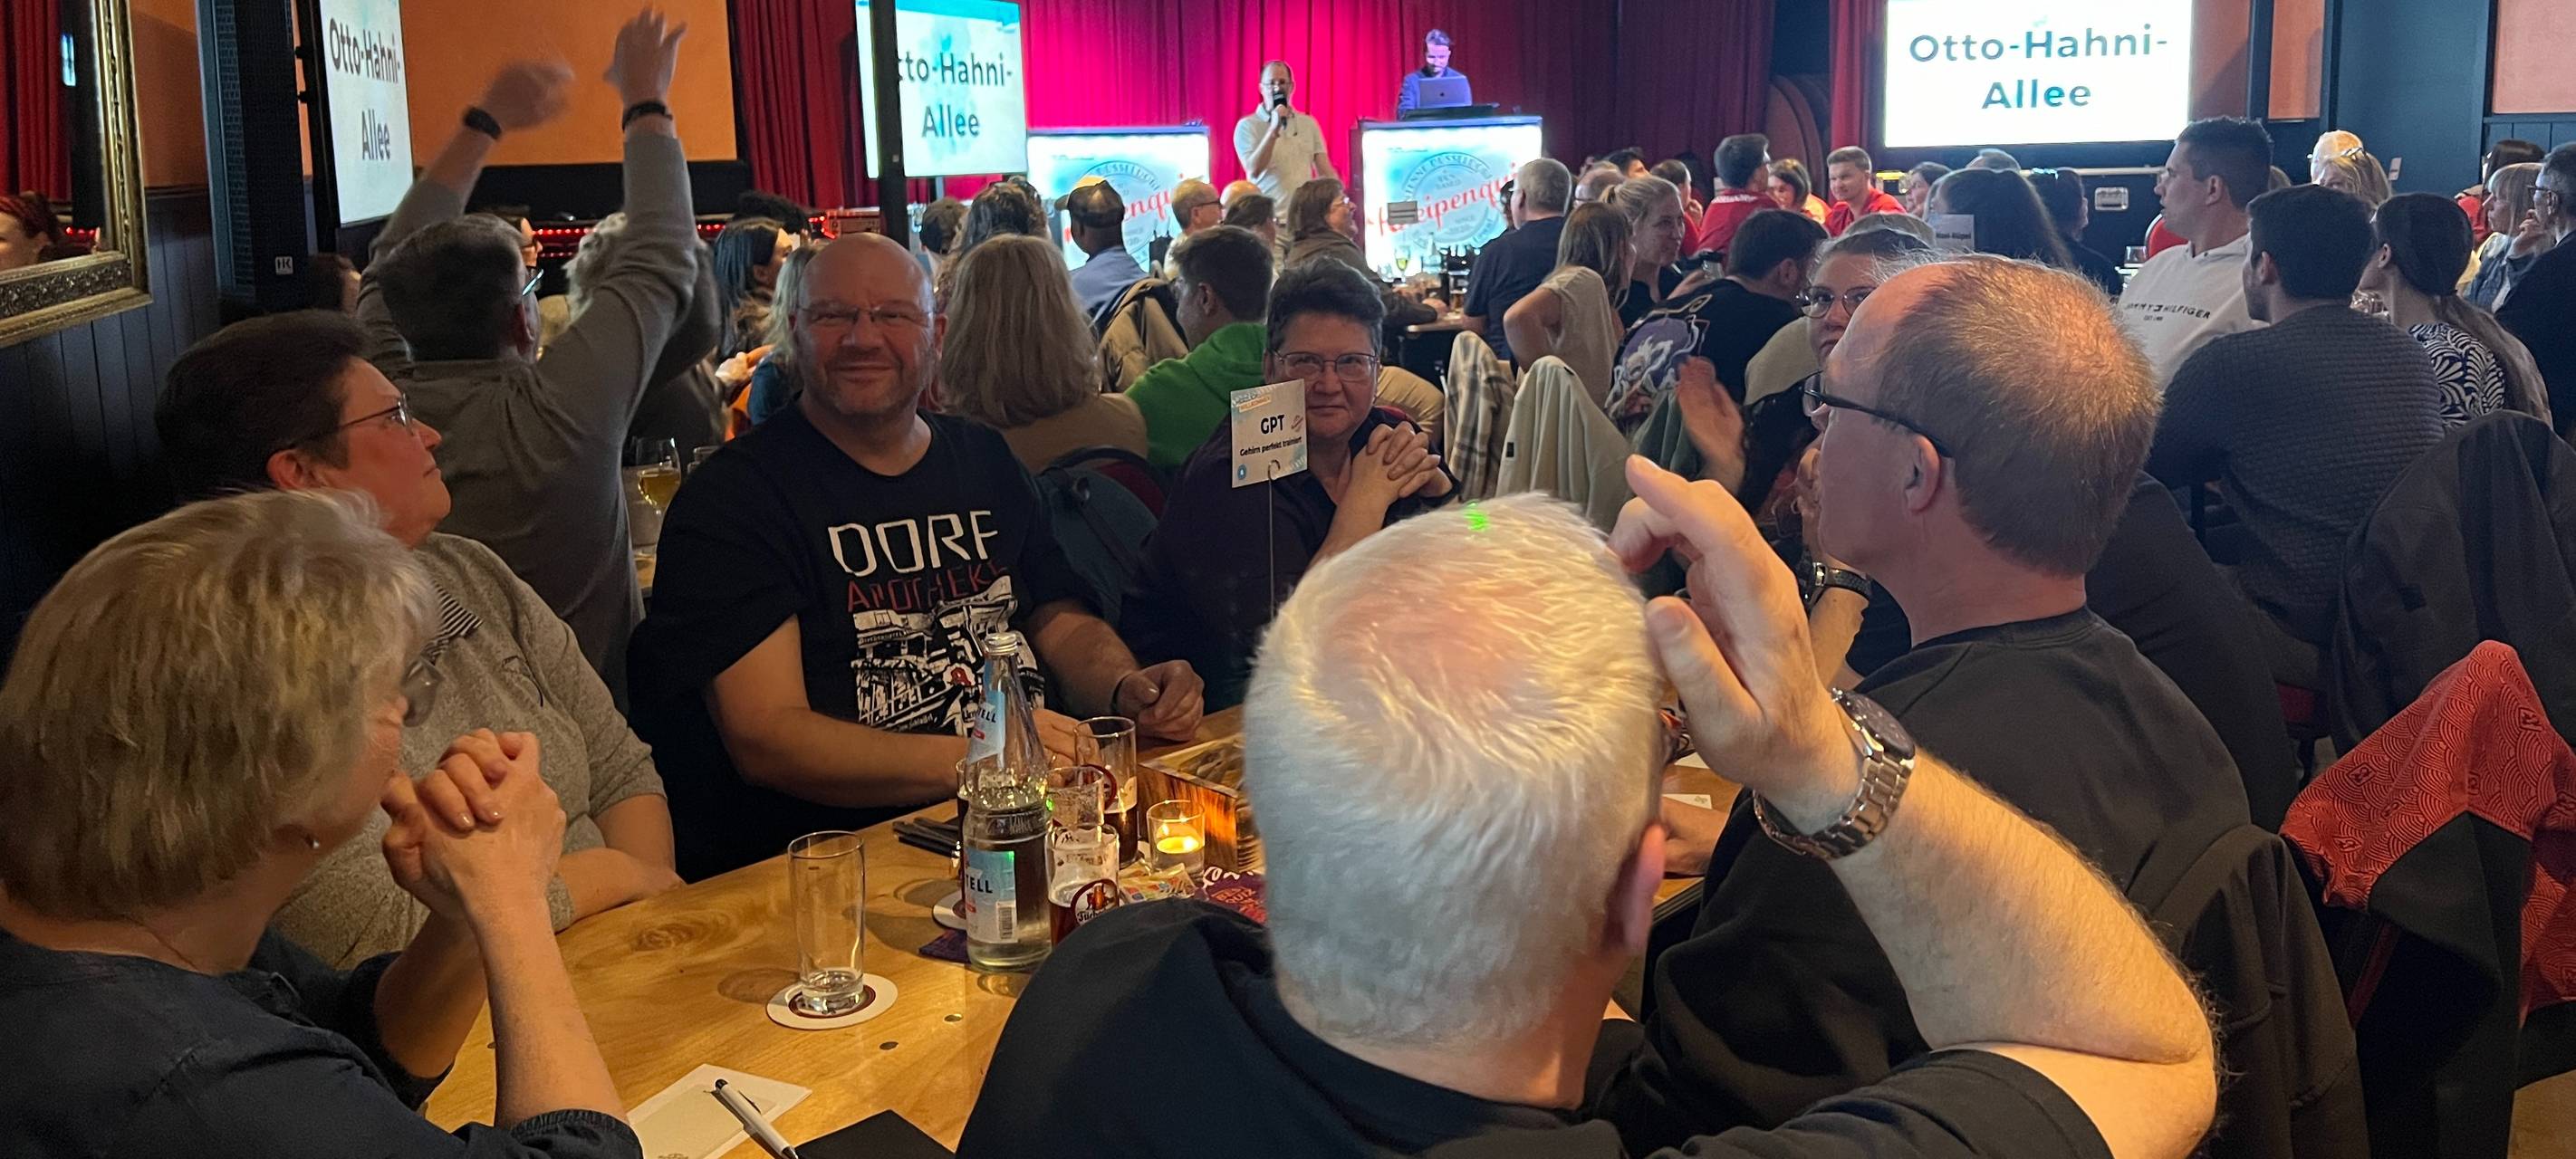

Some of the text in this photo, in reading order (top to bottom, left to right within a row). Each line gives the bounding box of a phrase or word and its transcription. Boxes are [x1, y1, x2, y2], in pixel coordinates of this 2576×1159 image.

[330, 18, 400, 83] Otto-Hahni-
[1909, 23, 2167, 62] Otto-Hahni-
[1981, 78, 2091, 110] Allee
[362, 109, 390, 160] Allee
[922, 104, 979, 138] Allee
[1260, 414, 1284, 435] GPT
[1240, 446, 1261, 456] Gehirn
[828, 510, 998, 577] DORF
